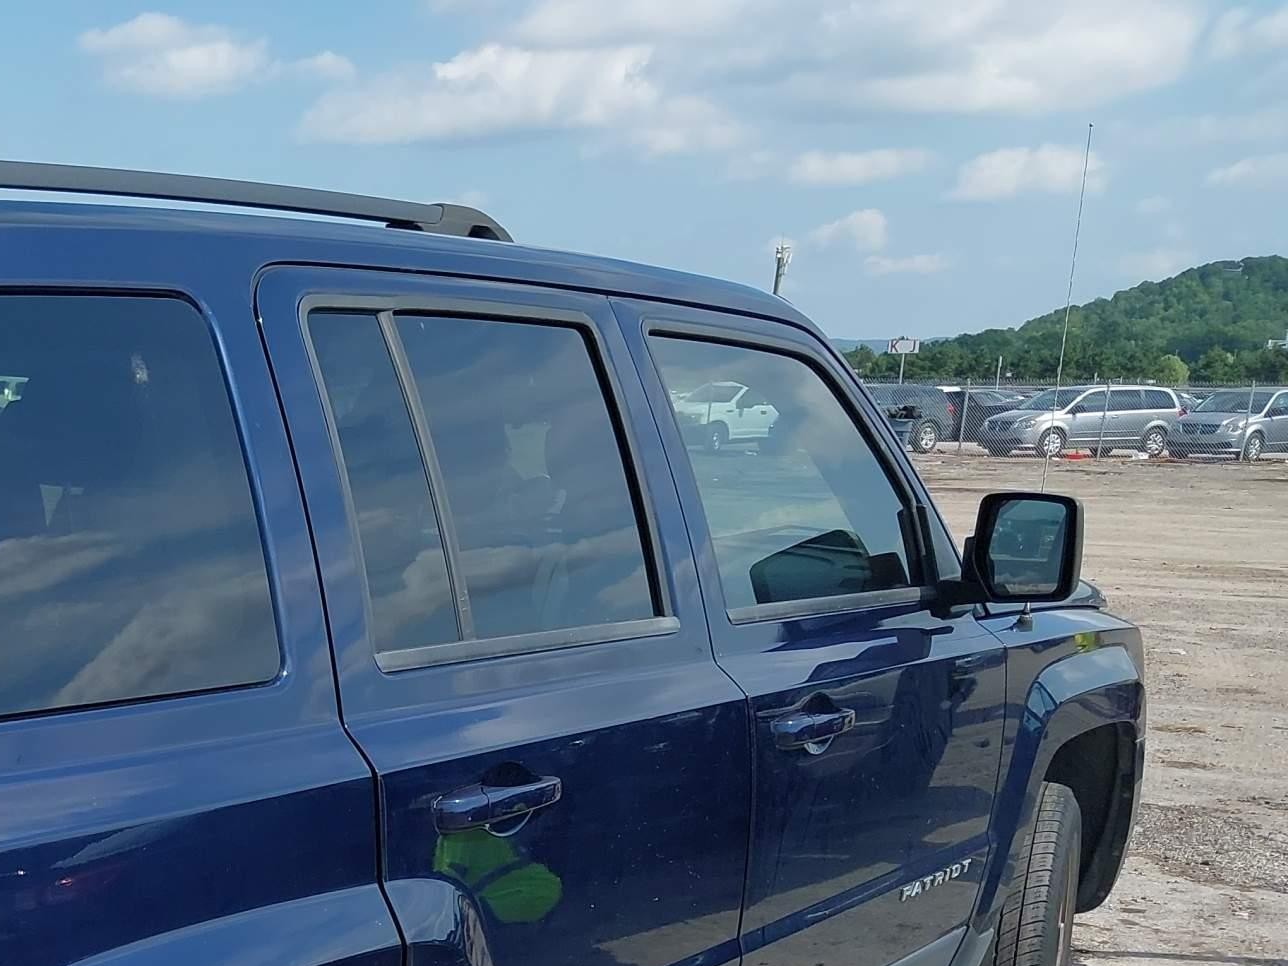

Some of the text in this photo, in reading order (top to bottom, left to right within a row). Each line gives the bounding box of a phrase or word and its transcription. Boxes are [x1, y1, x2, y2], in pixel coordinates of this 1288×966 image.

[890, 340, 916, 353] K J
[901, 858, 972, 902] PATRIOT
